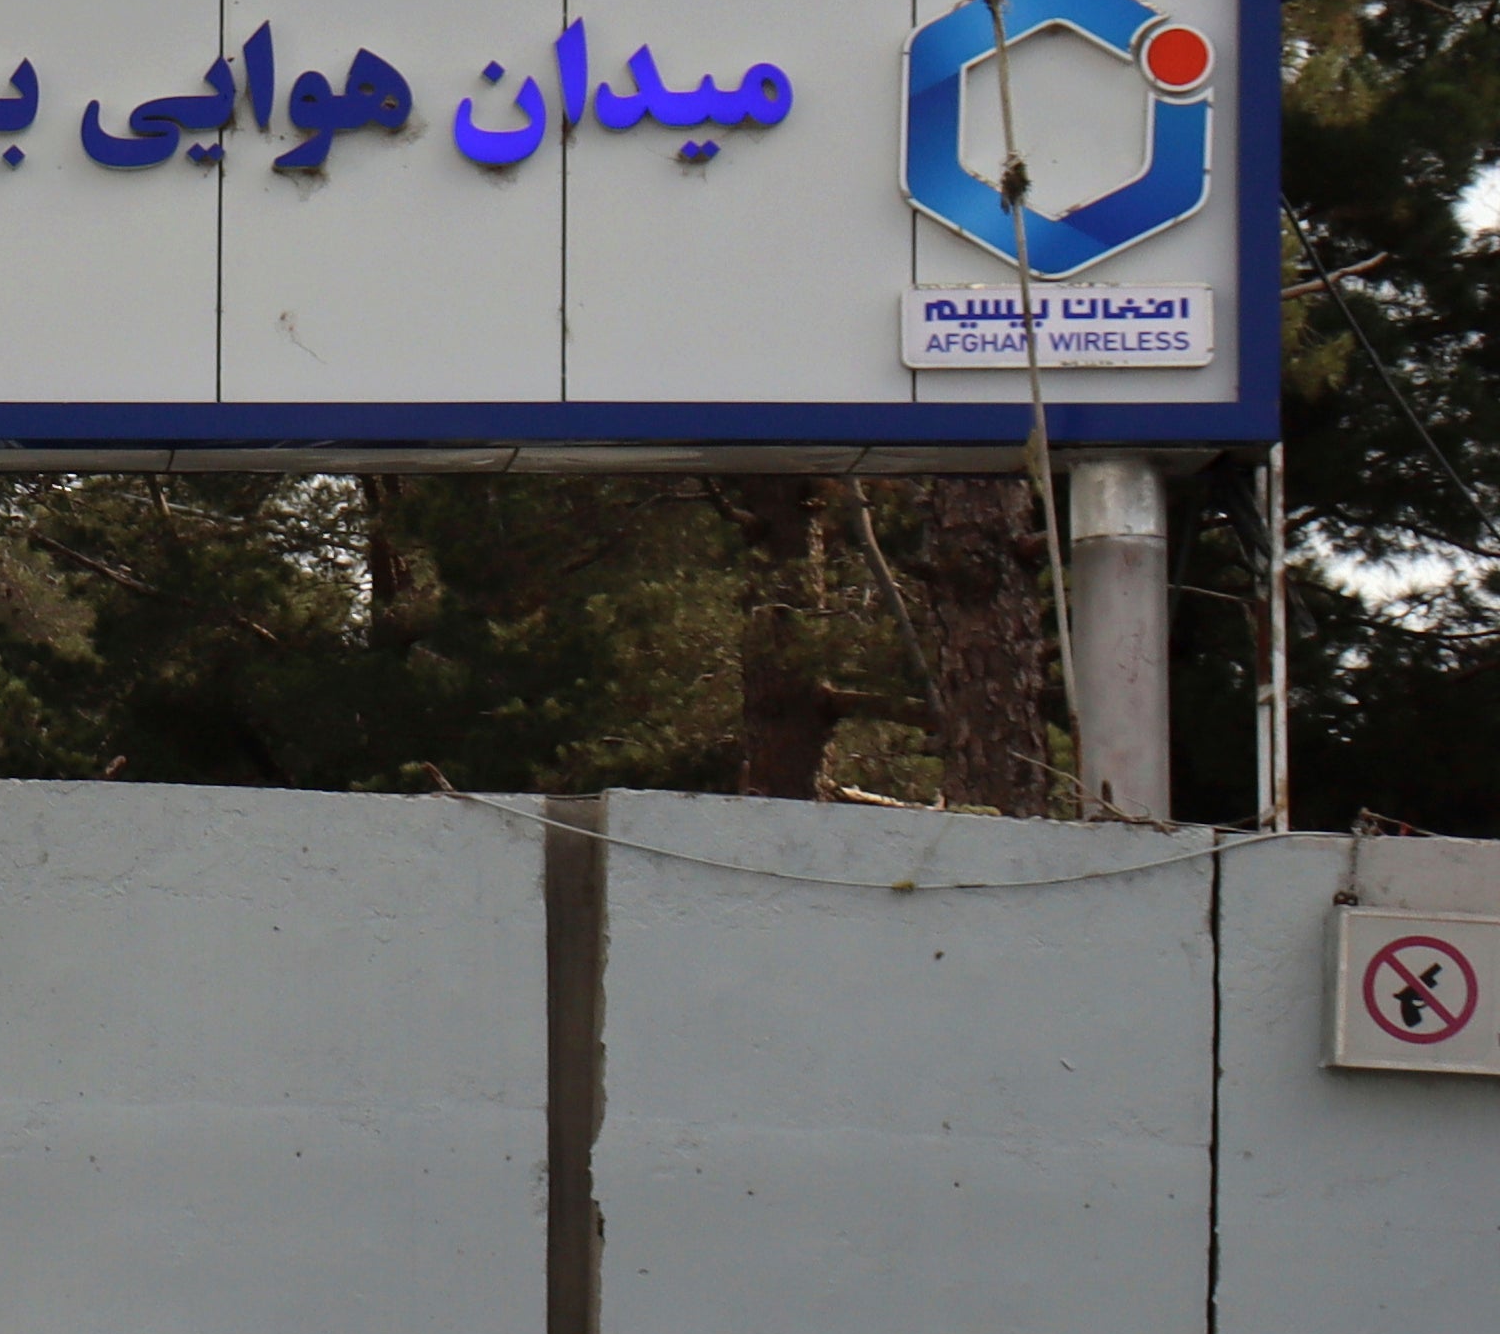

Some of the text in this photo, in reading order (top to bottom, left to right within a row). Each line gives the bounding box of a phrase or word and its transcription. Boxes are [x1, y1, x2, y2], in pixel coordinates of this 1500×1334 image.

[81, 23, 413, 169] هوایی
[453, 19, 794, 165] میدان
[1048, 331, 1192, 352] WIRELESS
